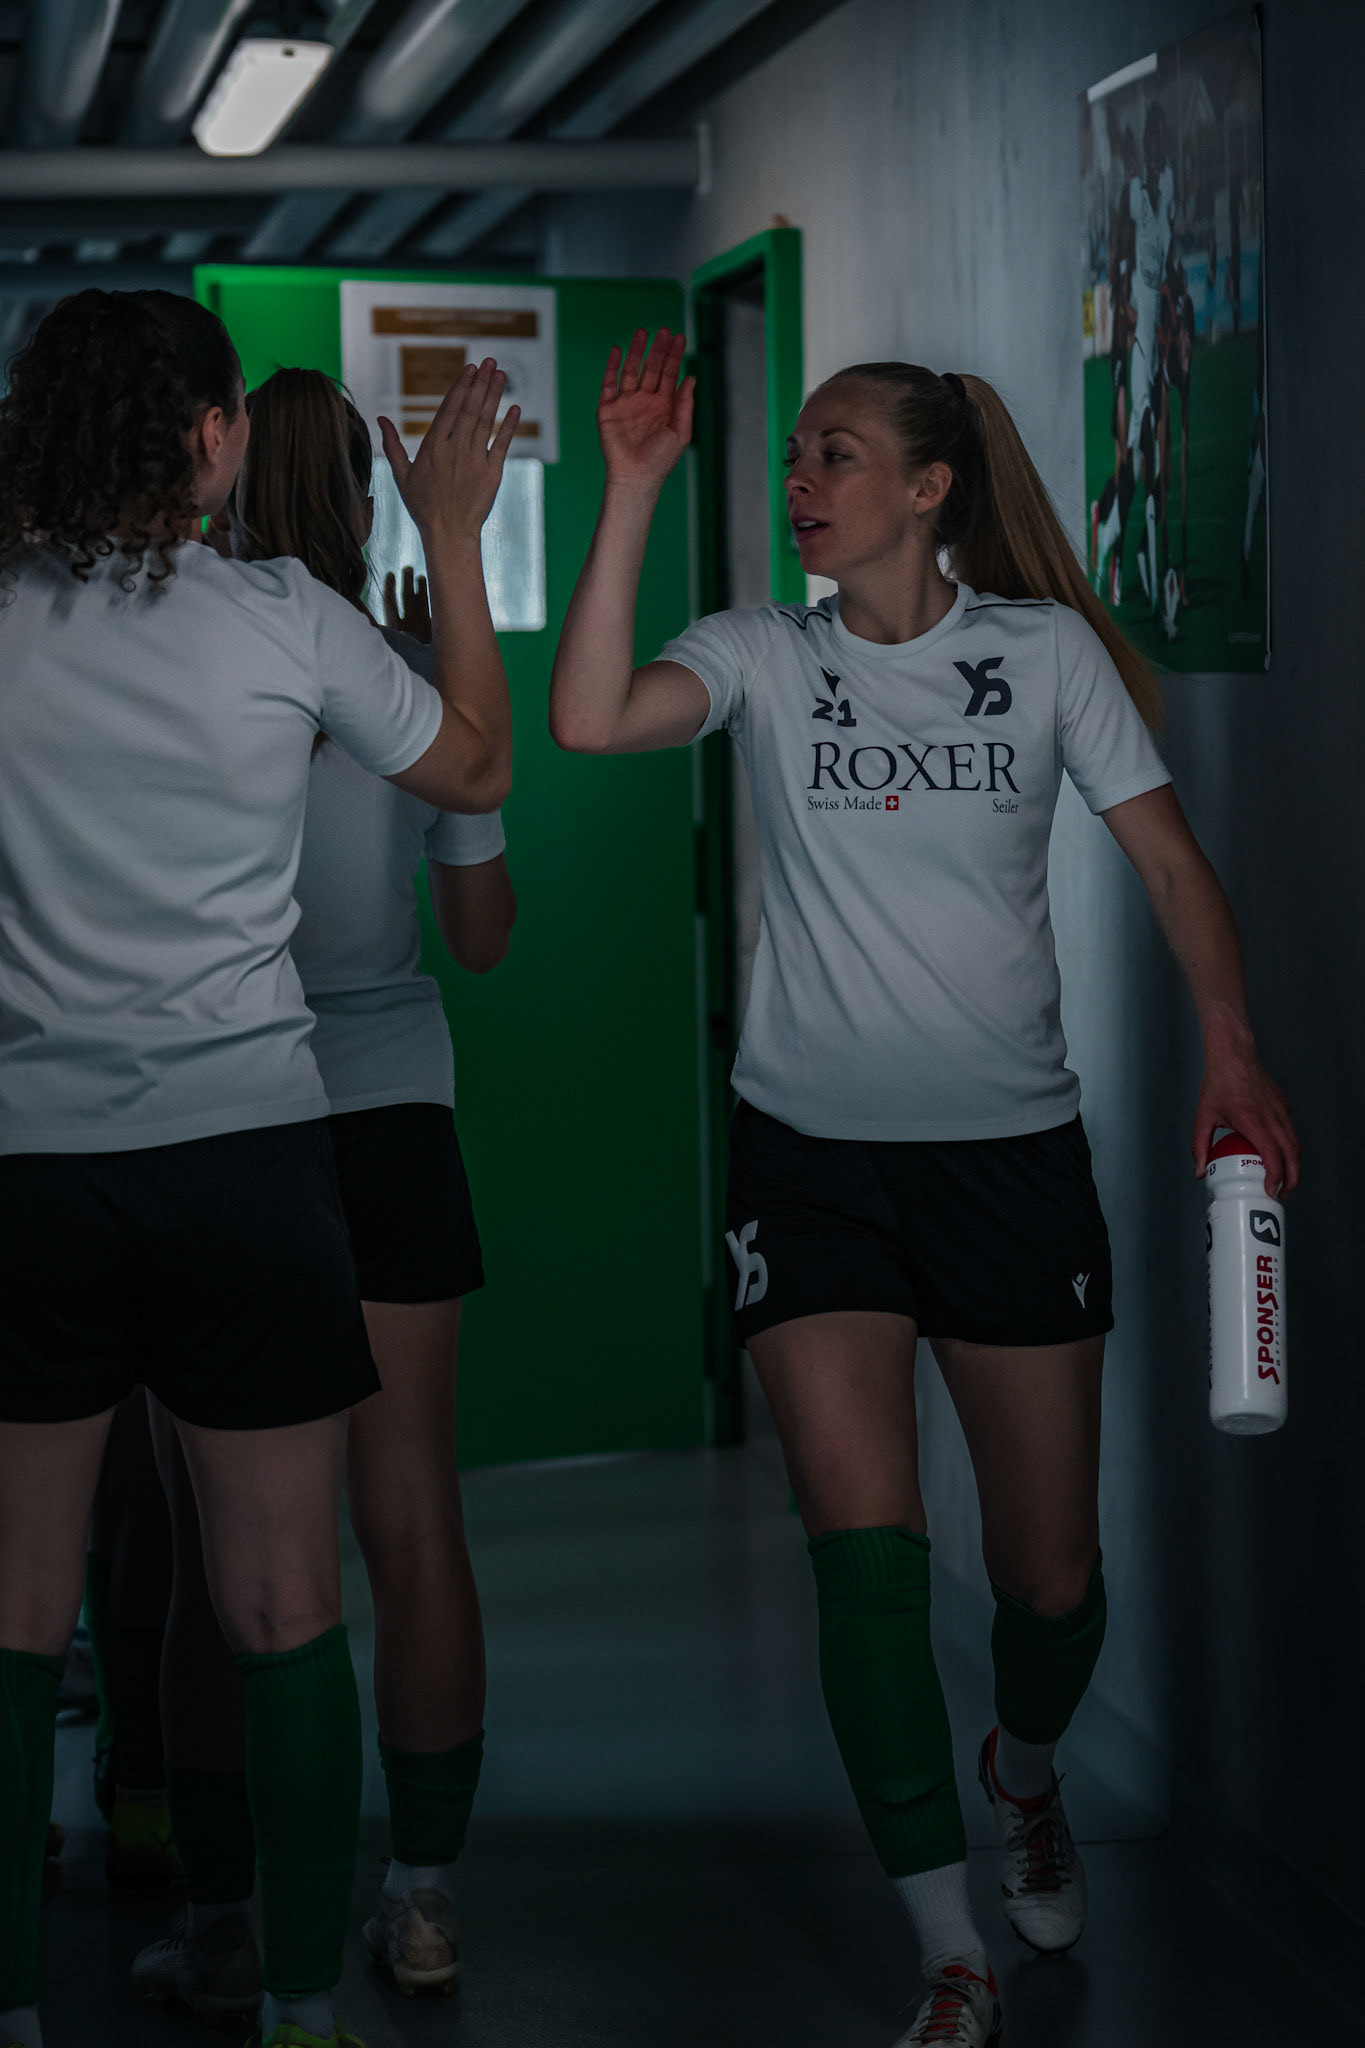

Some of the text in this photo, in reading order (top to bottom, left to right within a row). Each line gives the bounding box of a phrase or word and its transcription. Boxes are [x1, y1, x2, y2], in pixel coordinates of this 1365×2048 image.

[812, 697, 857, 727] 21
[807, 742, 1021, 794] ROXER
[807, 796, 882, 811] Swiss Made
[992, 798, 1019, 814] Seiler
[1241, 1159, 1264, 1167] SPON
[1257, 1255, 1280, 1385] SPONSER
